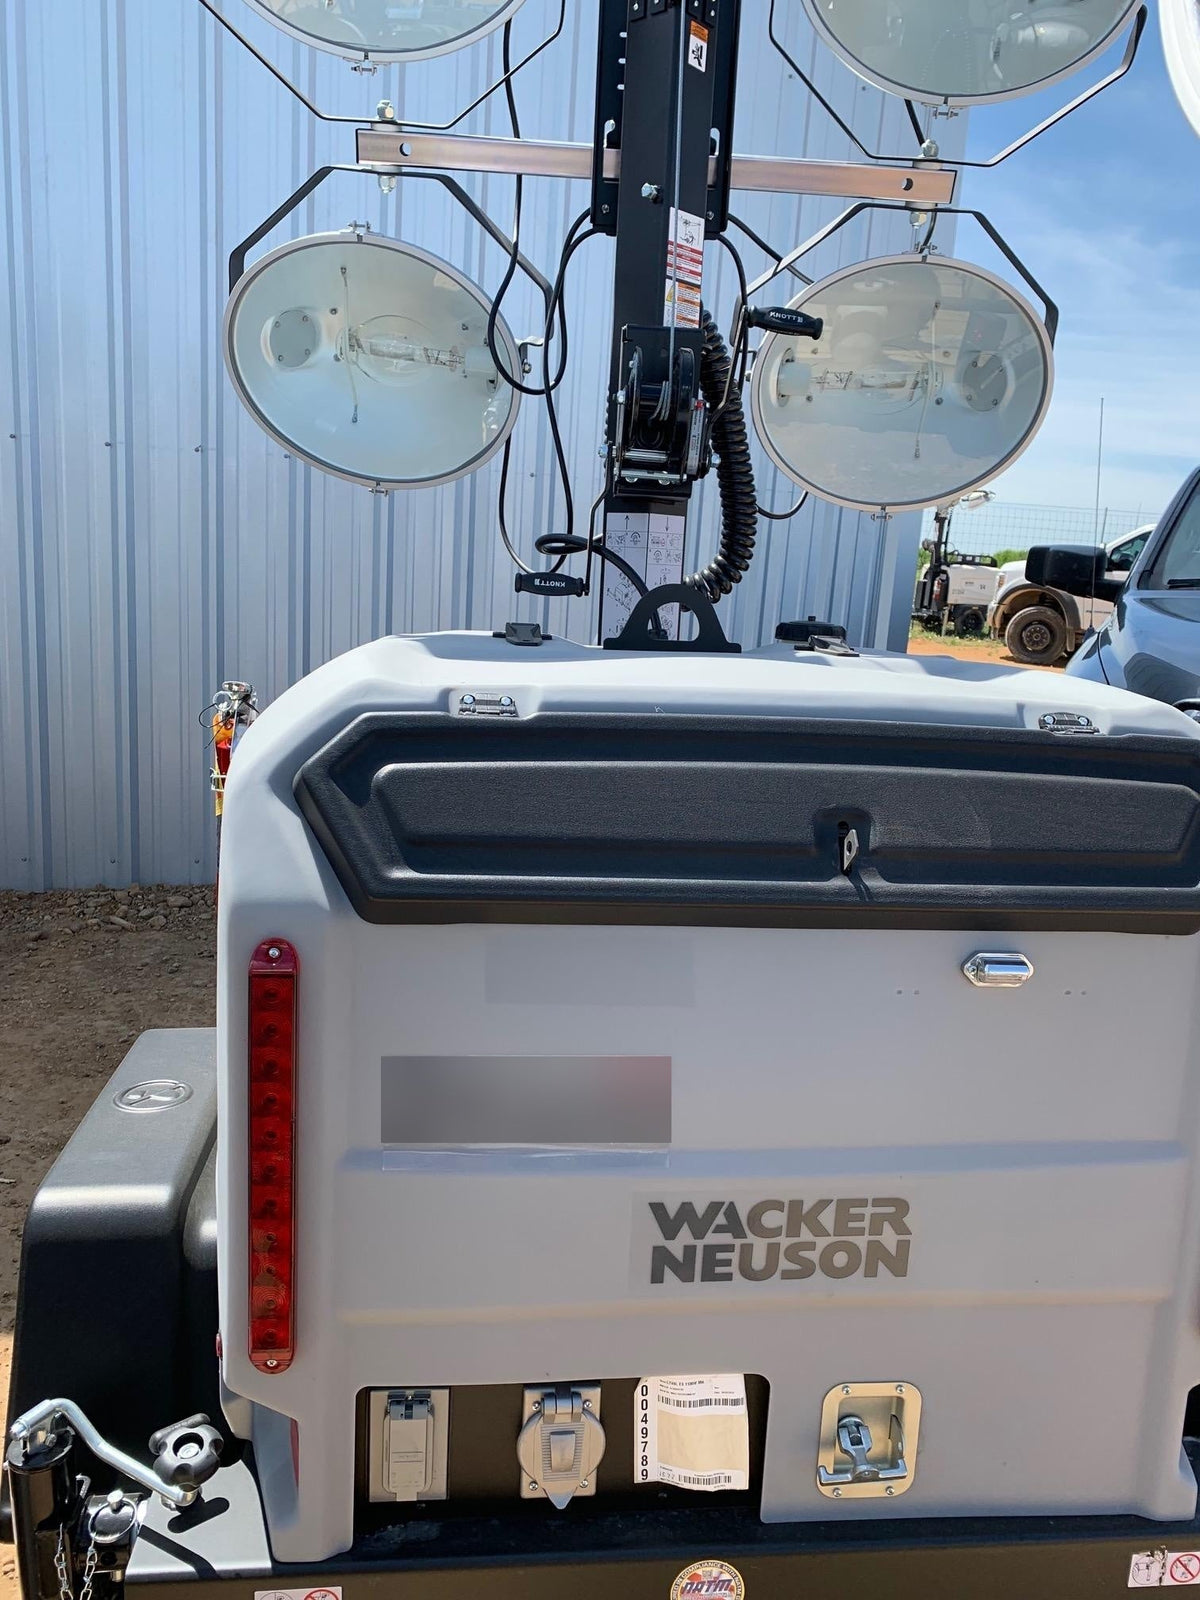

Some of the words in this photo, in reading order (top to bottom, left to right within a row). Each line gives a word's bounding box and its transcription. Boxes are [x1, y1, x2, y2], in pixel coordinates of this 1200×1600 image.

[769, 311, 796, 321] KNOTT
[648, 1198, 912, 1240] WACKER
[650, 1240, 911, 1284] NEUSON
[682, 1562, 722, 1580] COMPLIANCE
[723, 1564, 737, 1579] WITH
[682, 1579, 733, 1595] NATM
